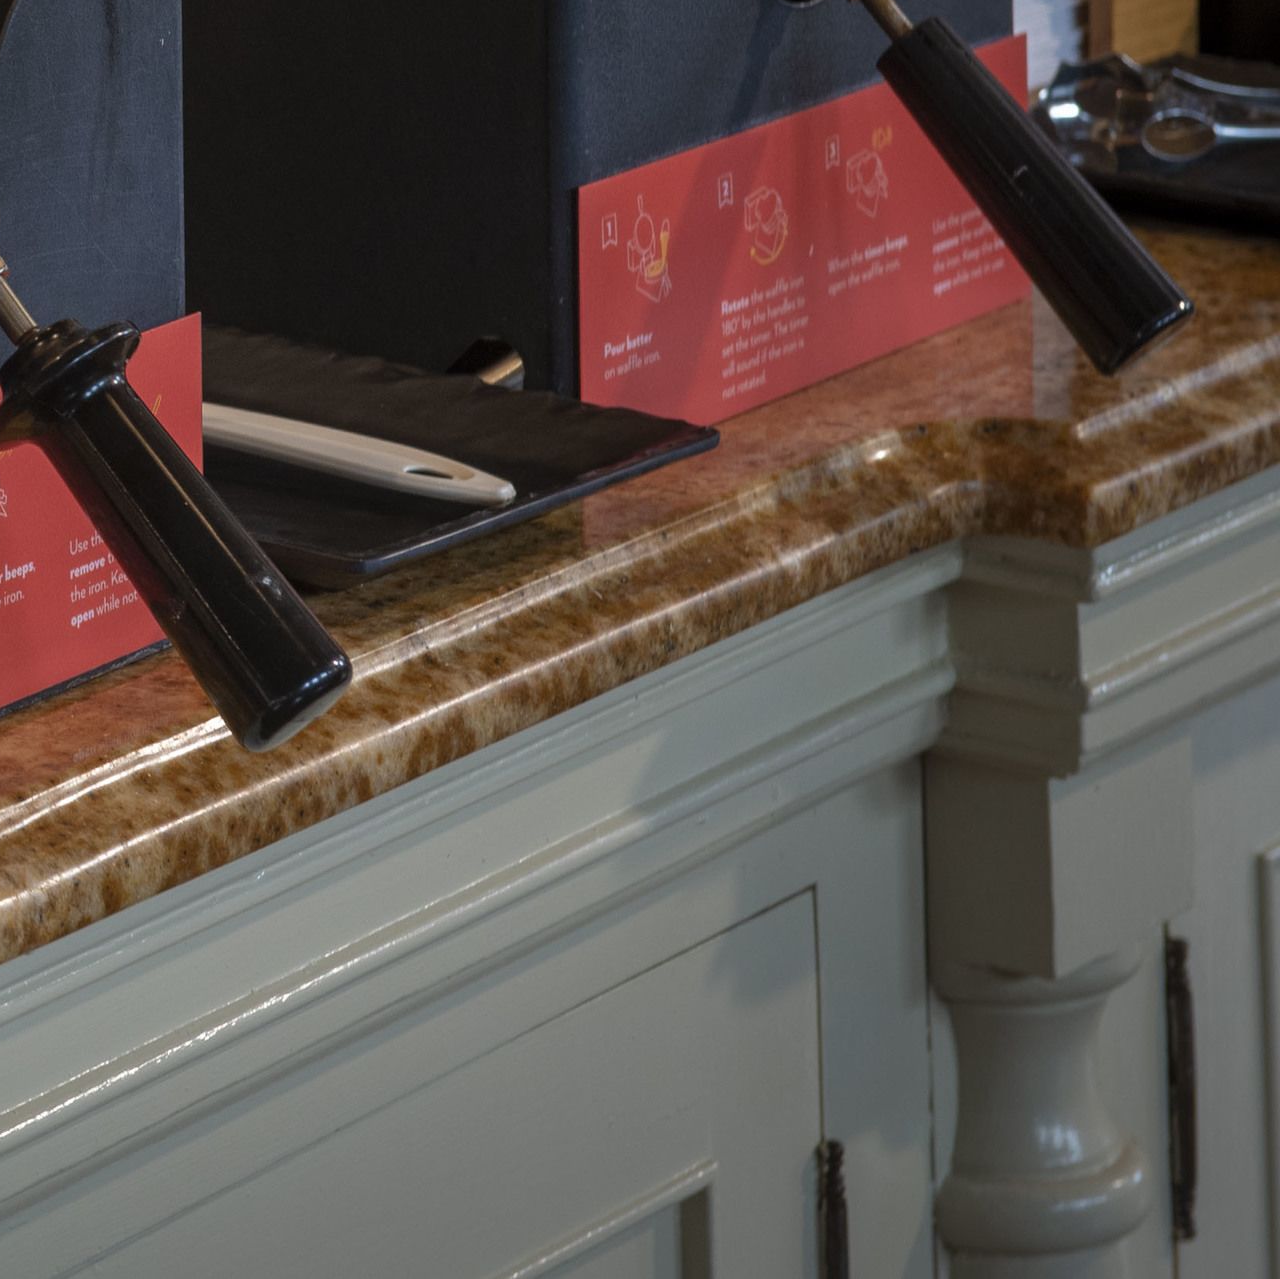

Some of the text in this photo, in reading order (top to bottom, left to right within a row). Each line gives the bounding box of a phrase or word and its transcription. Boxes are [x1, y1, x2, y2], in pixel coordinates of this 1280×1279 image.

[69, 537, 88, 556] Use
[70, 557, 106, 580] remove
[3, 589, 25, 606] iron.
[70, 569, 129, 603] the iron. Kee
[70, 589, 138, 629] open while not
